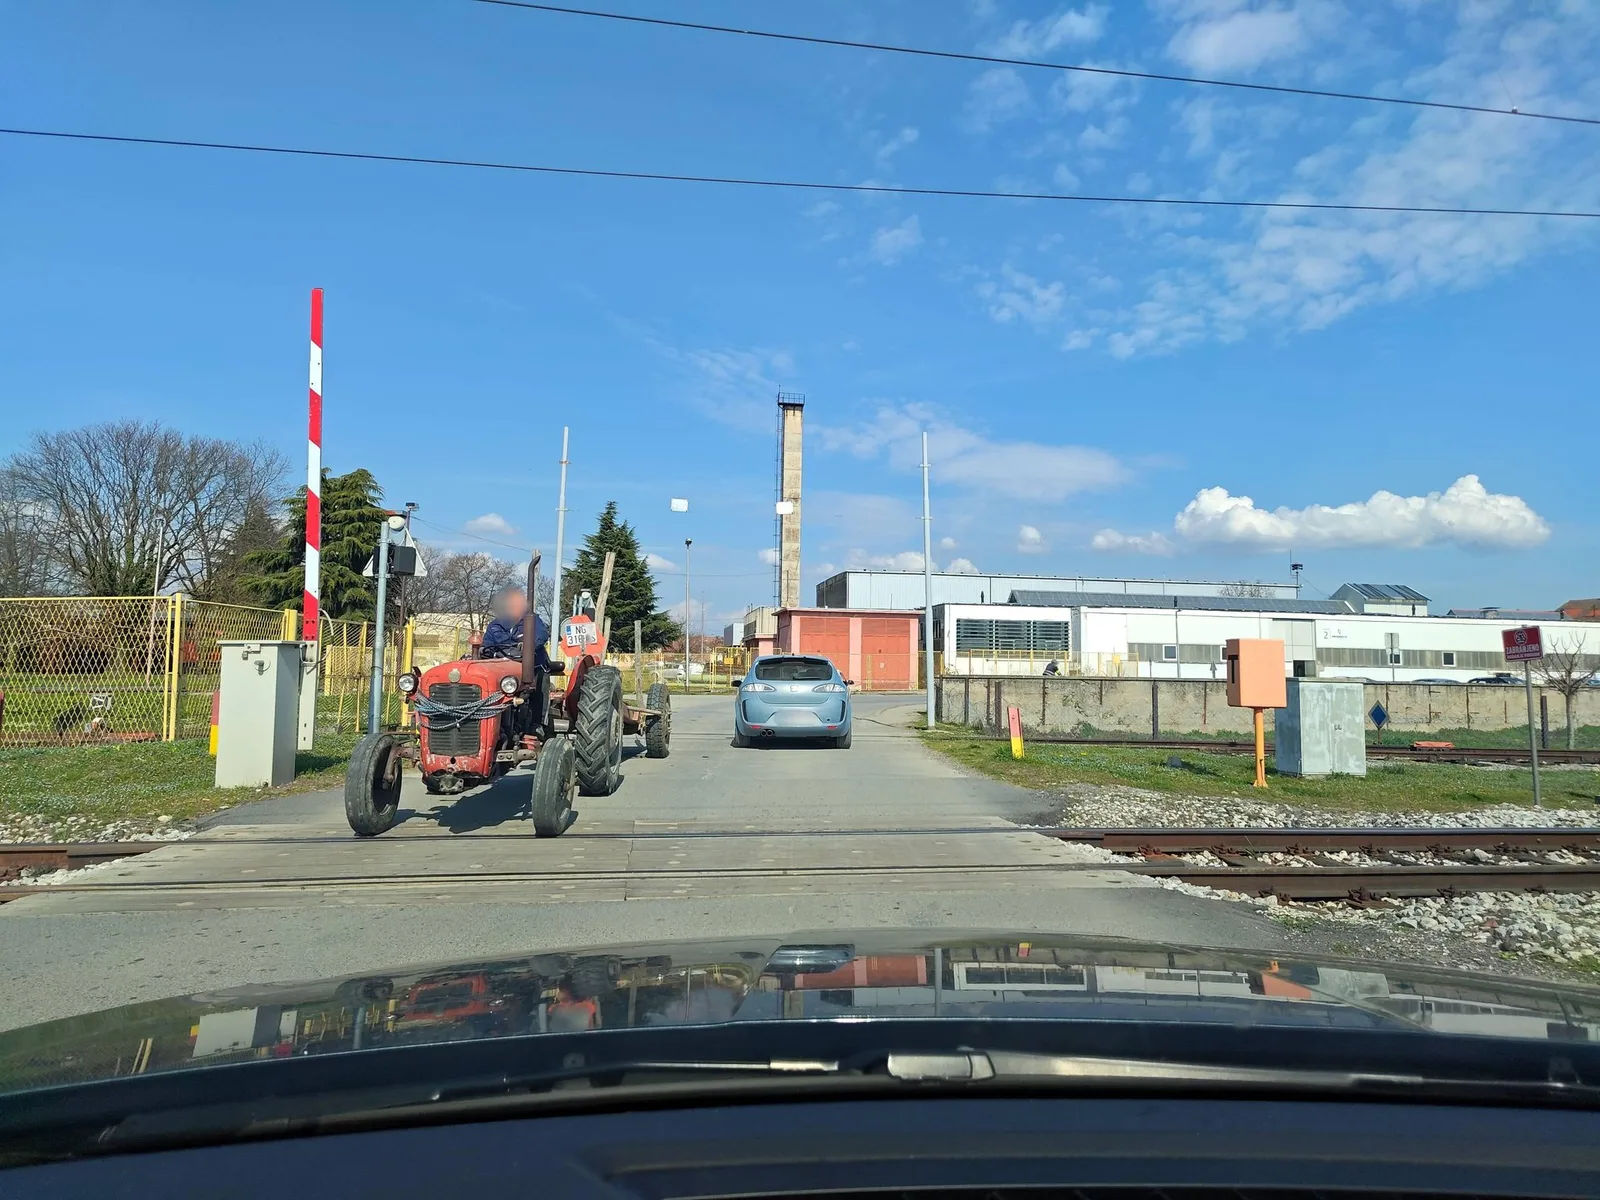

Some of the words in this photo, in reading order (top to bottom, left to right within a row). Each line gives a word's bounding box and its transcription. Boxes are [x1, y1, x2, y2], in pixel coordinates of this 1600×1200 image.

[575, 624, 587, 634] NG
[1323, 631, 1329, 639] 2
[1505, 643, 1540, 655] ZABRANJENO
